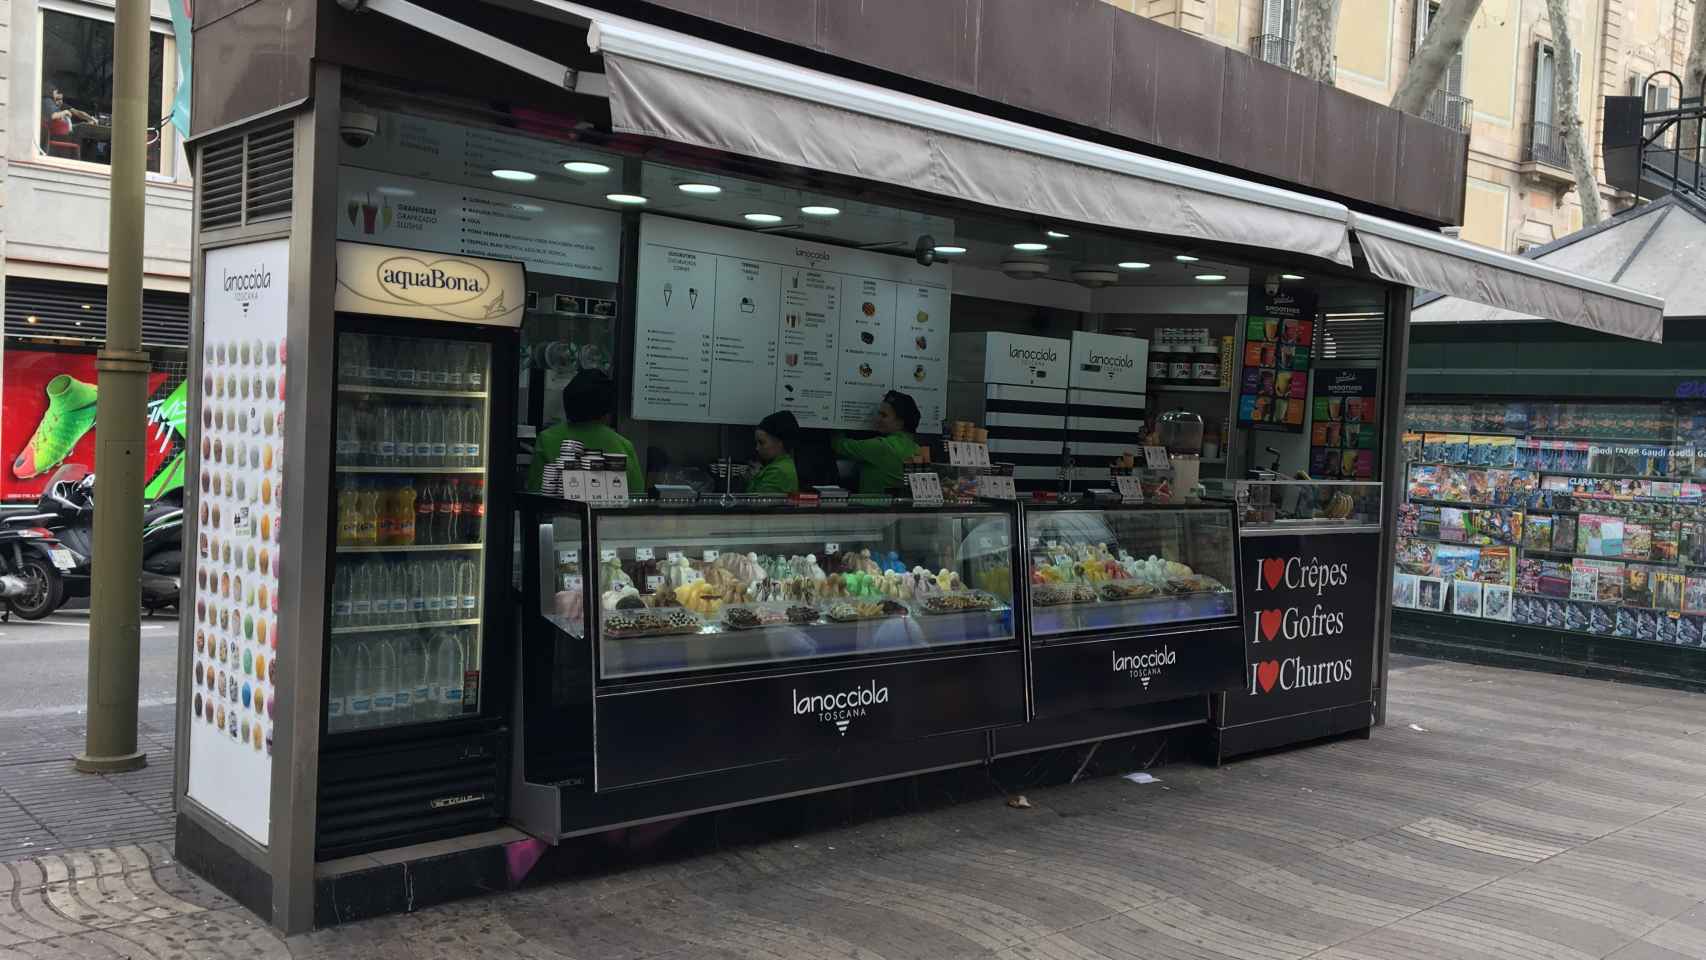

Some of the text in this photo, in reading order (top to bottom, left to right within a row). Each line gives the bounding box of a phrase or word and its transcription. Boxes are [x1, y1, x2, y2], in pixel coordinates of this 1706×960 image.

[223, 263, 271, 291] lanocciola
[383, 268, 479, 292] aquaBona
[1009, 343, 1056, 362] lanocciola
[1089, 350, 1134, 369] lanocciola
[1285, 556, 1349, 596] Crêpes
[1282, 603, 1345, 640] Gofres
[1112, 643, 1176, 672] lanocciola
[1129, 667, 1162, 680] TOSCANA
[1279, 656, 1353, 691] Churros
[792, 679, 888, 715] lanocciola
[818, 708, 866, 721] TOSCANA
